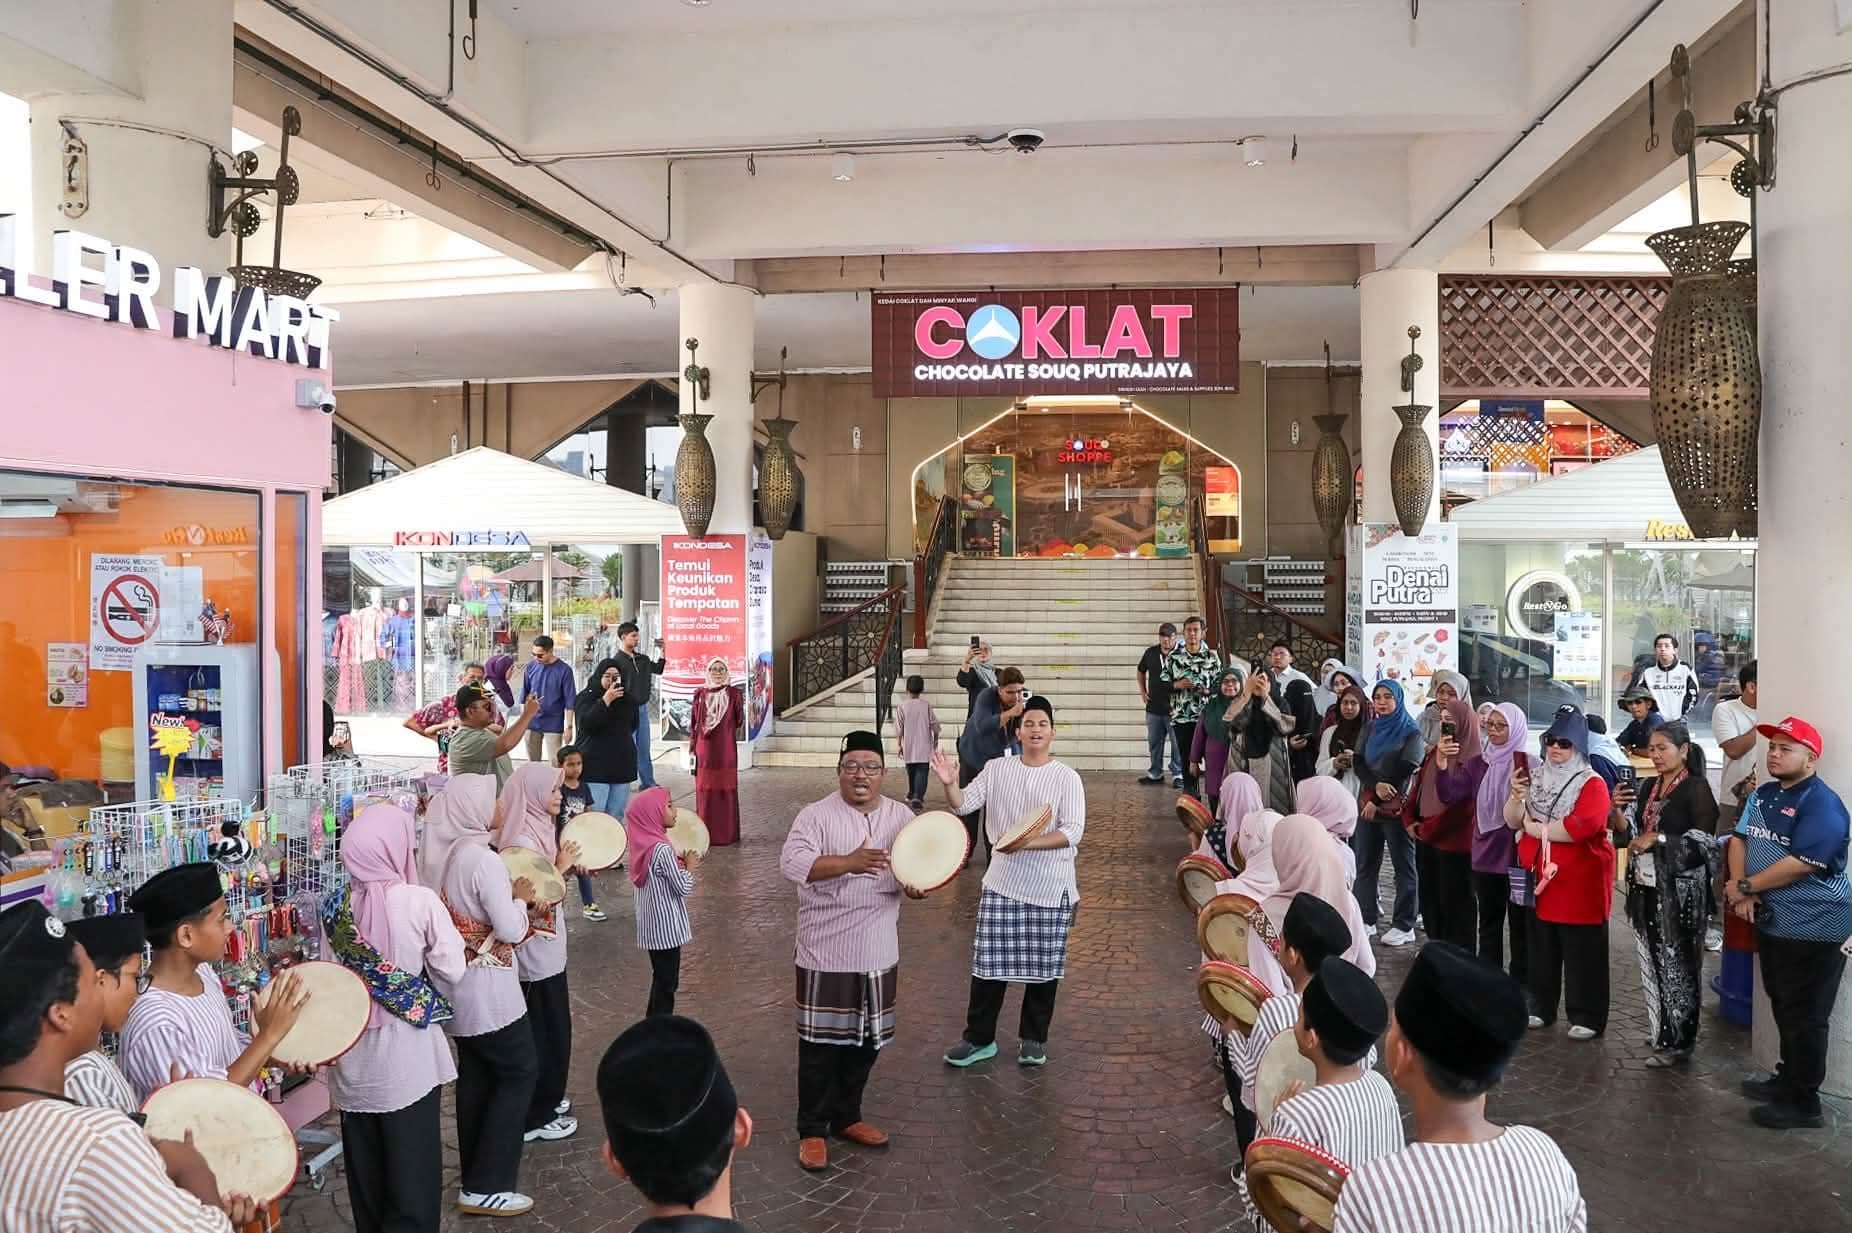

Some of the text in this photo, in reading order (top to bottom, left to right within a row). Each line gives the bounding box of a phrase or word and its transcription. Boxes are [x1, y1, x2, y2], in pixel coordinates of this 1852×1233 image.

[0, 214, 340, 369] LER MART
[914, 362, 1193, 381] CHOCOLATE SOUQ PUTRAJAYA
[1057, 452, 1112, 463] SHOPPE
[1645, 519, 1695, 540] Res
[668, 559, 711, 571] Temui
[668, 572, 733, 584] Keunikan
[1386, 564, 1449, 588] Denai
[668, 585, 716, 596] Produk
[1370, 580, 1433, 604] Putra
[668, 598, 739, 612] Tempatan
[151, 712, 186, 728] New!
